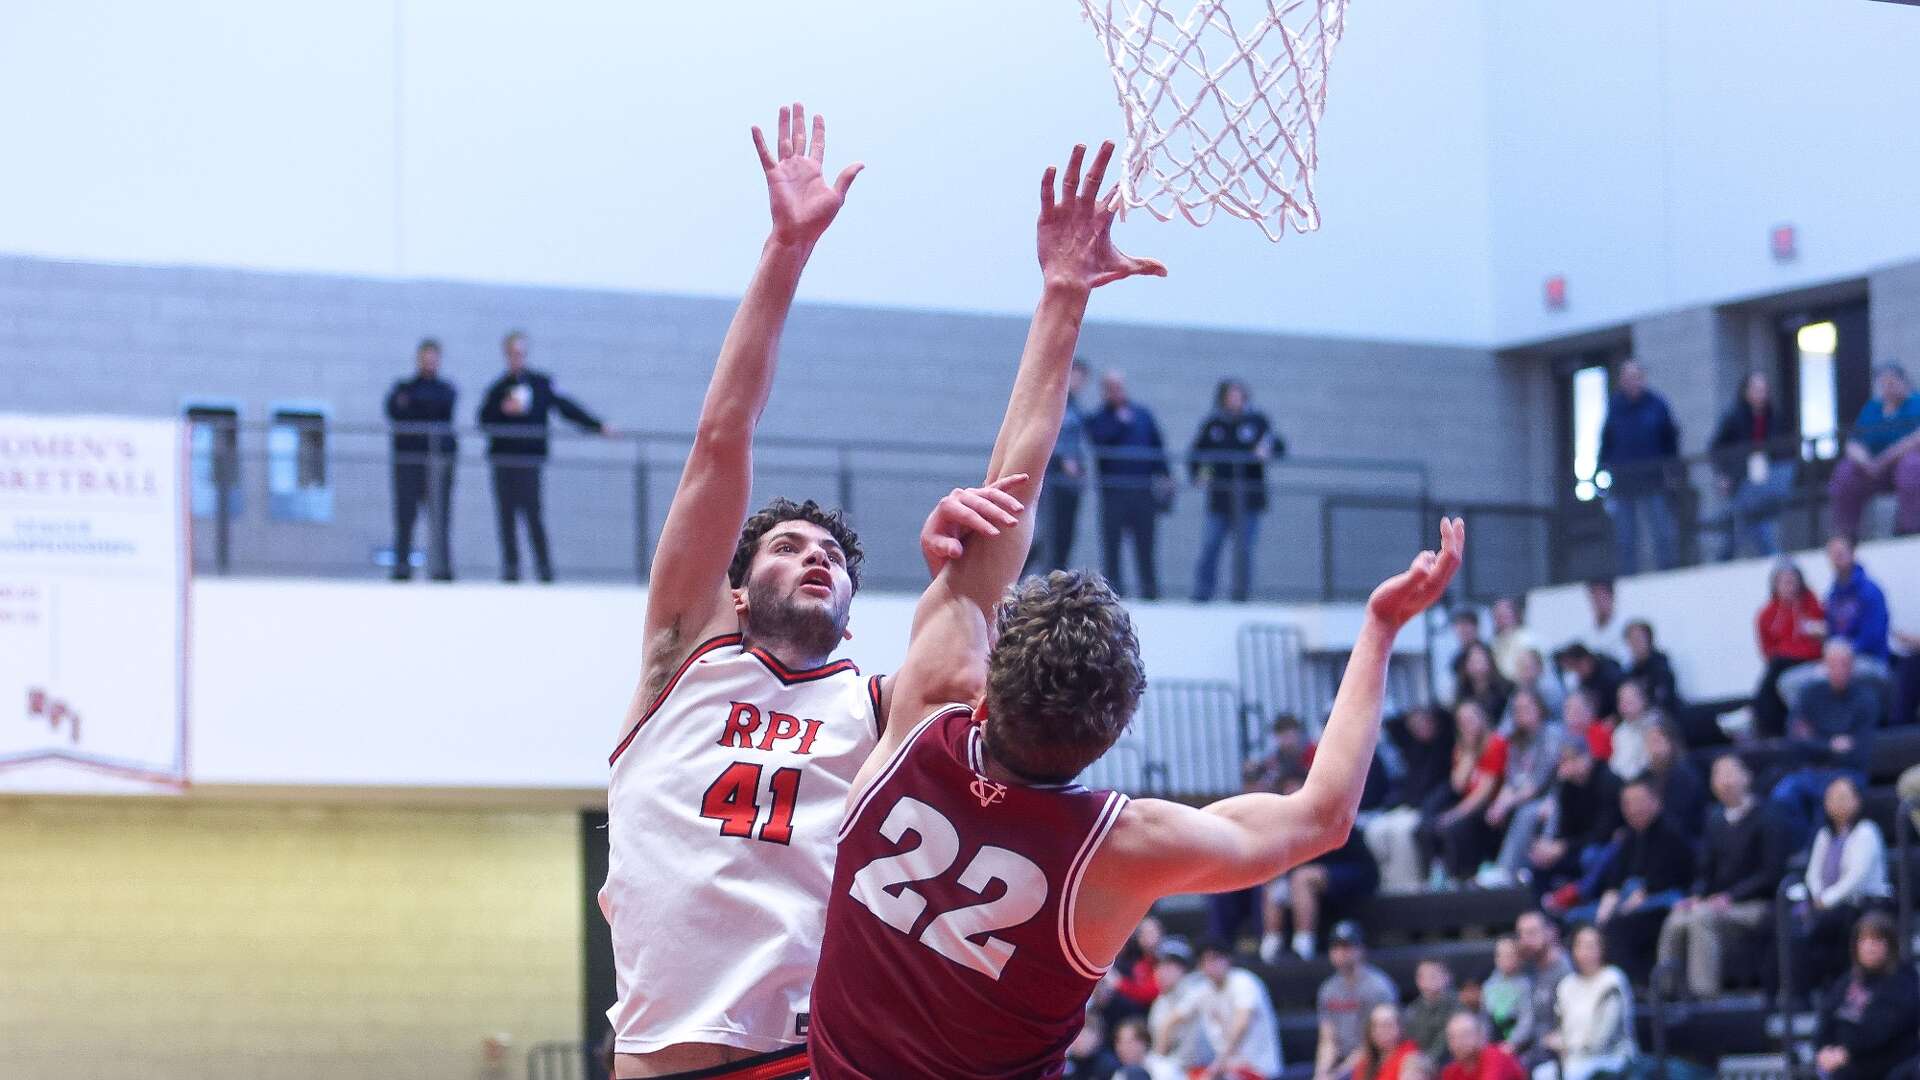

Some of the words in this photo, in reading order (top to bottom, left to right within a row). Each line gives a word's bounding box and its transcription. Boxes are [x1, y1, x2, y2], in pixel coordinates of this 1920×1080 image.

[716, 700, 824, 755] RPI
[700, 760, 802, 846] 41
[849, 796, 1048, 981] 22
